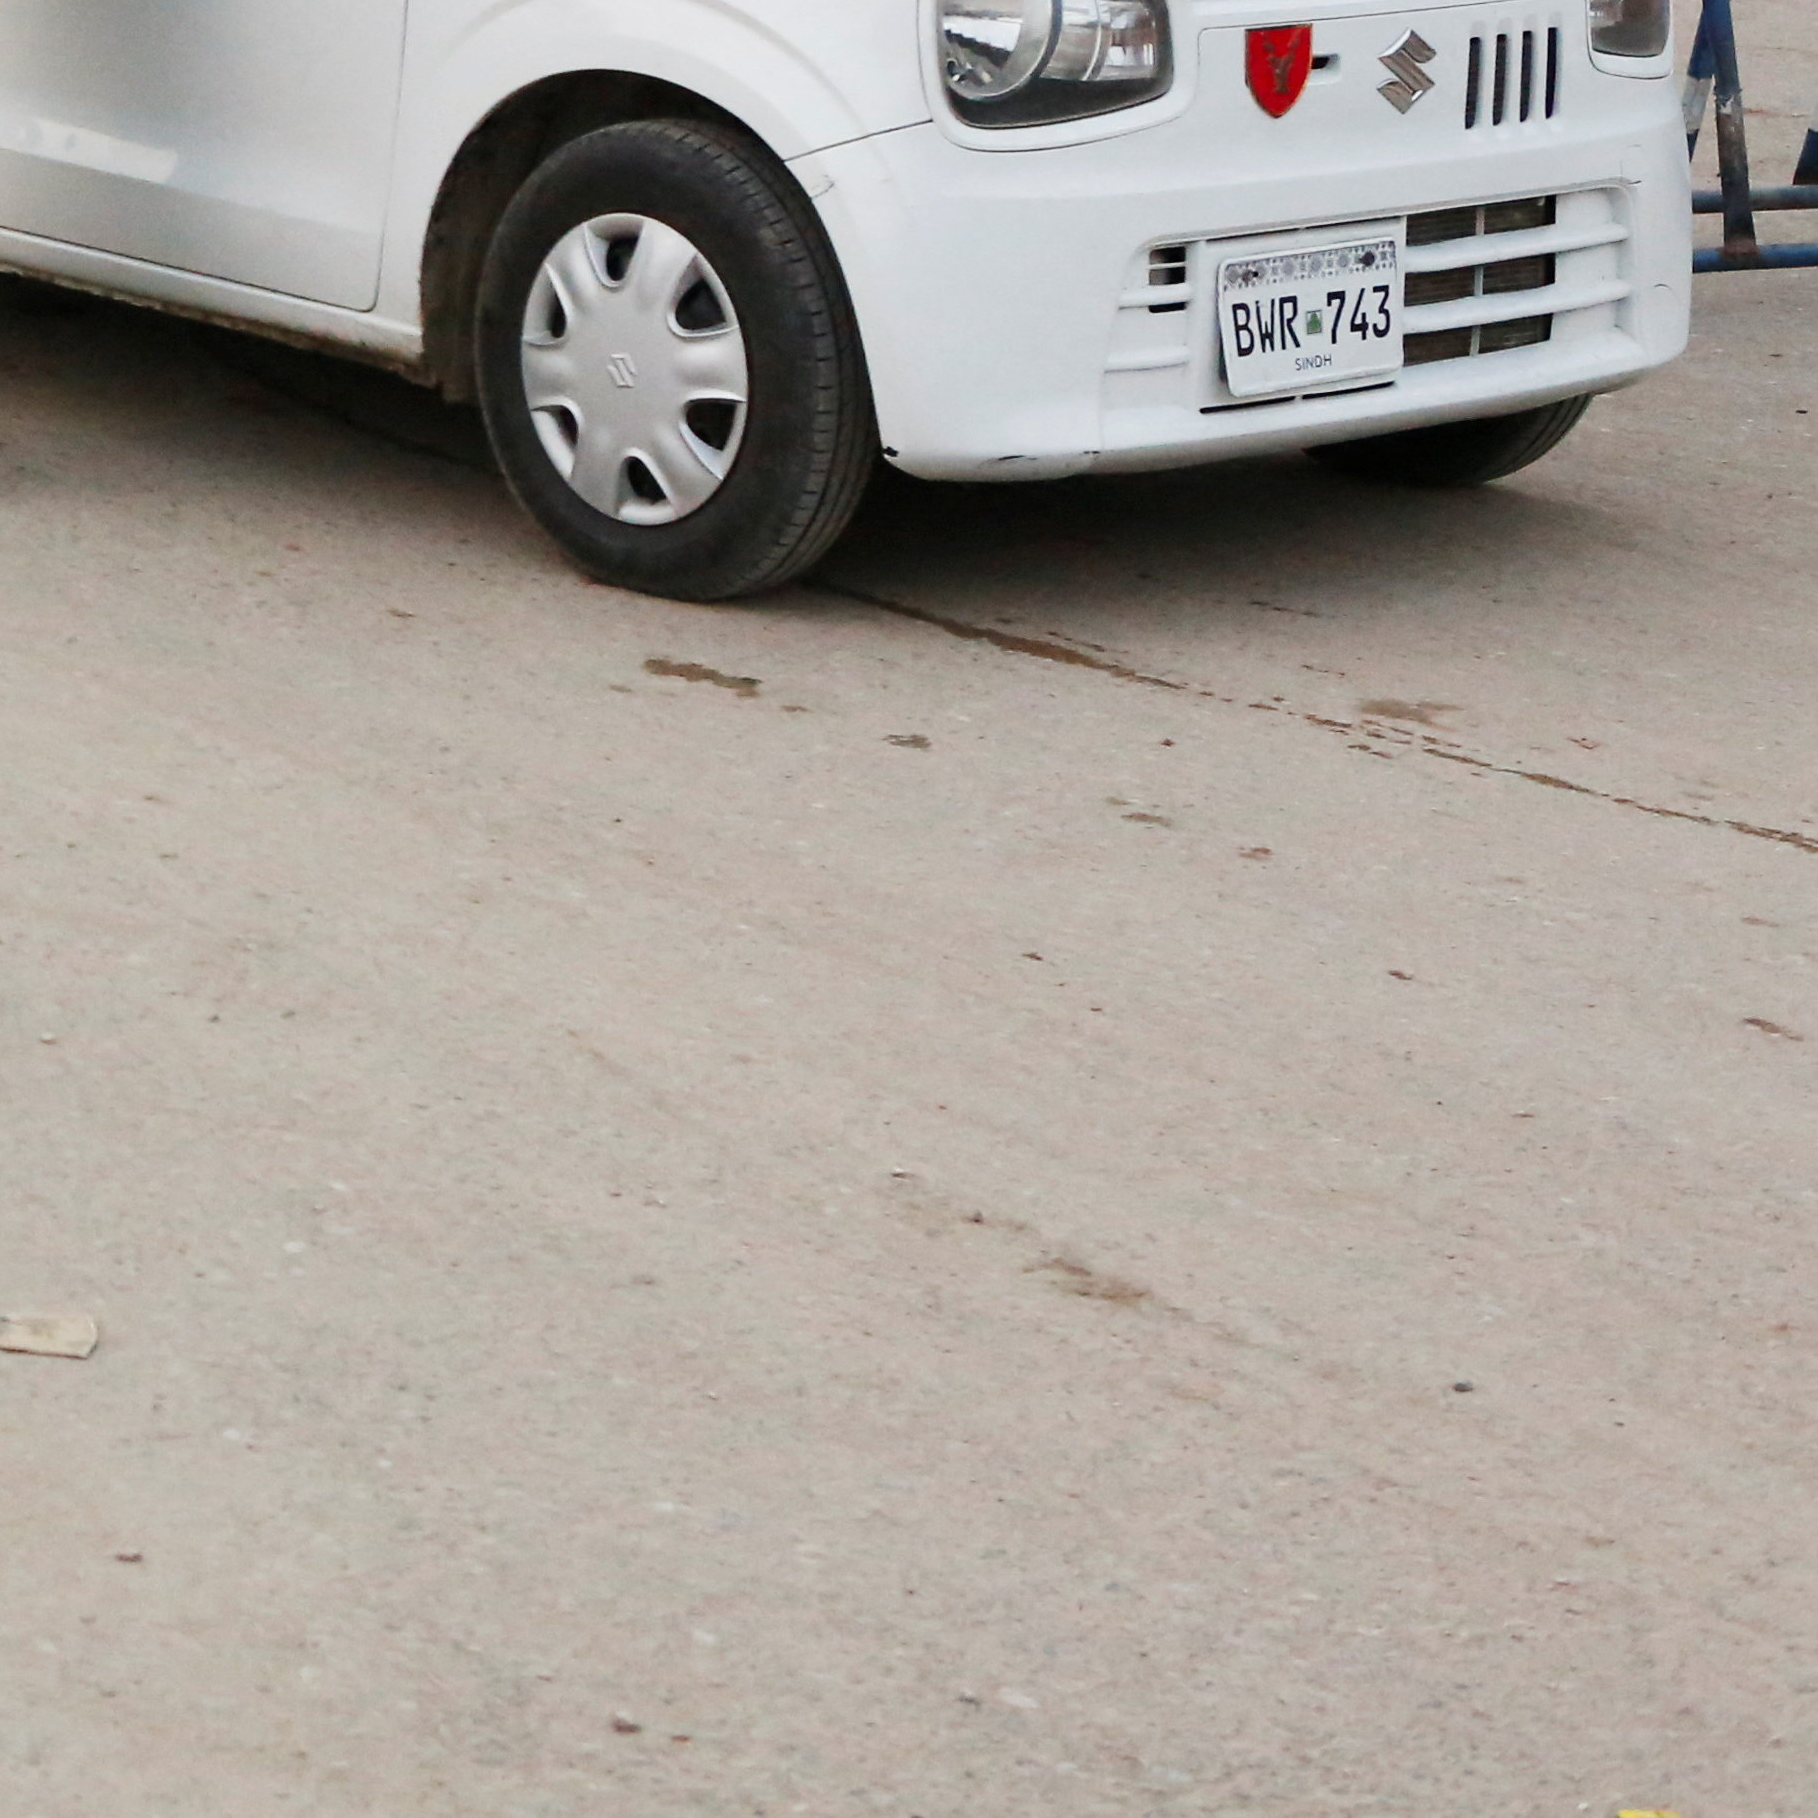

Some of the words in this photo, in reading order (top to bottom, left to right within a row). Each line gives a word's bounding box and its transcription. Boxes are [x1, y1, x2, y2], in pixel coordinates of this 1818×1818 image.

[1231, 294, 1302, 358] BWR
[1326, 284, 1392, 346] 743
[1294, 354, 1333, 372] SINDH
